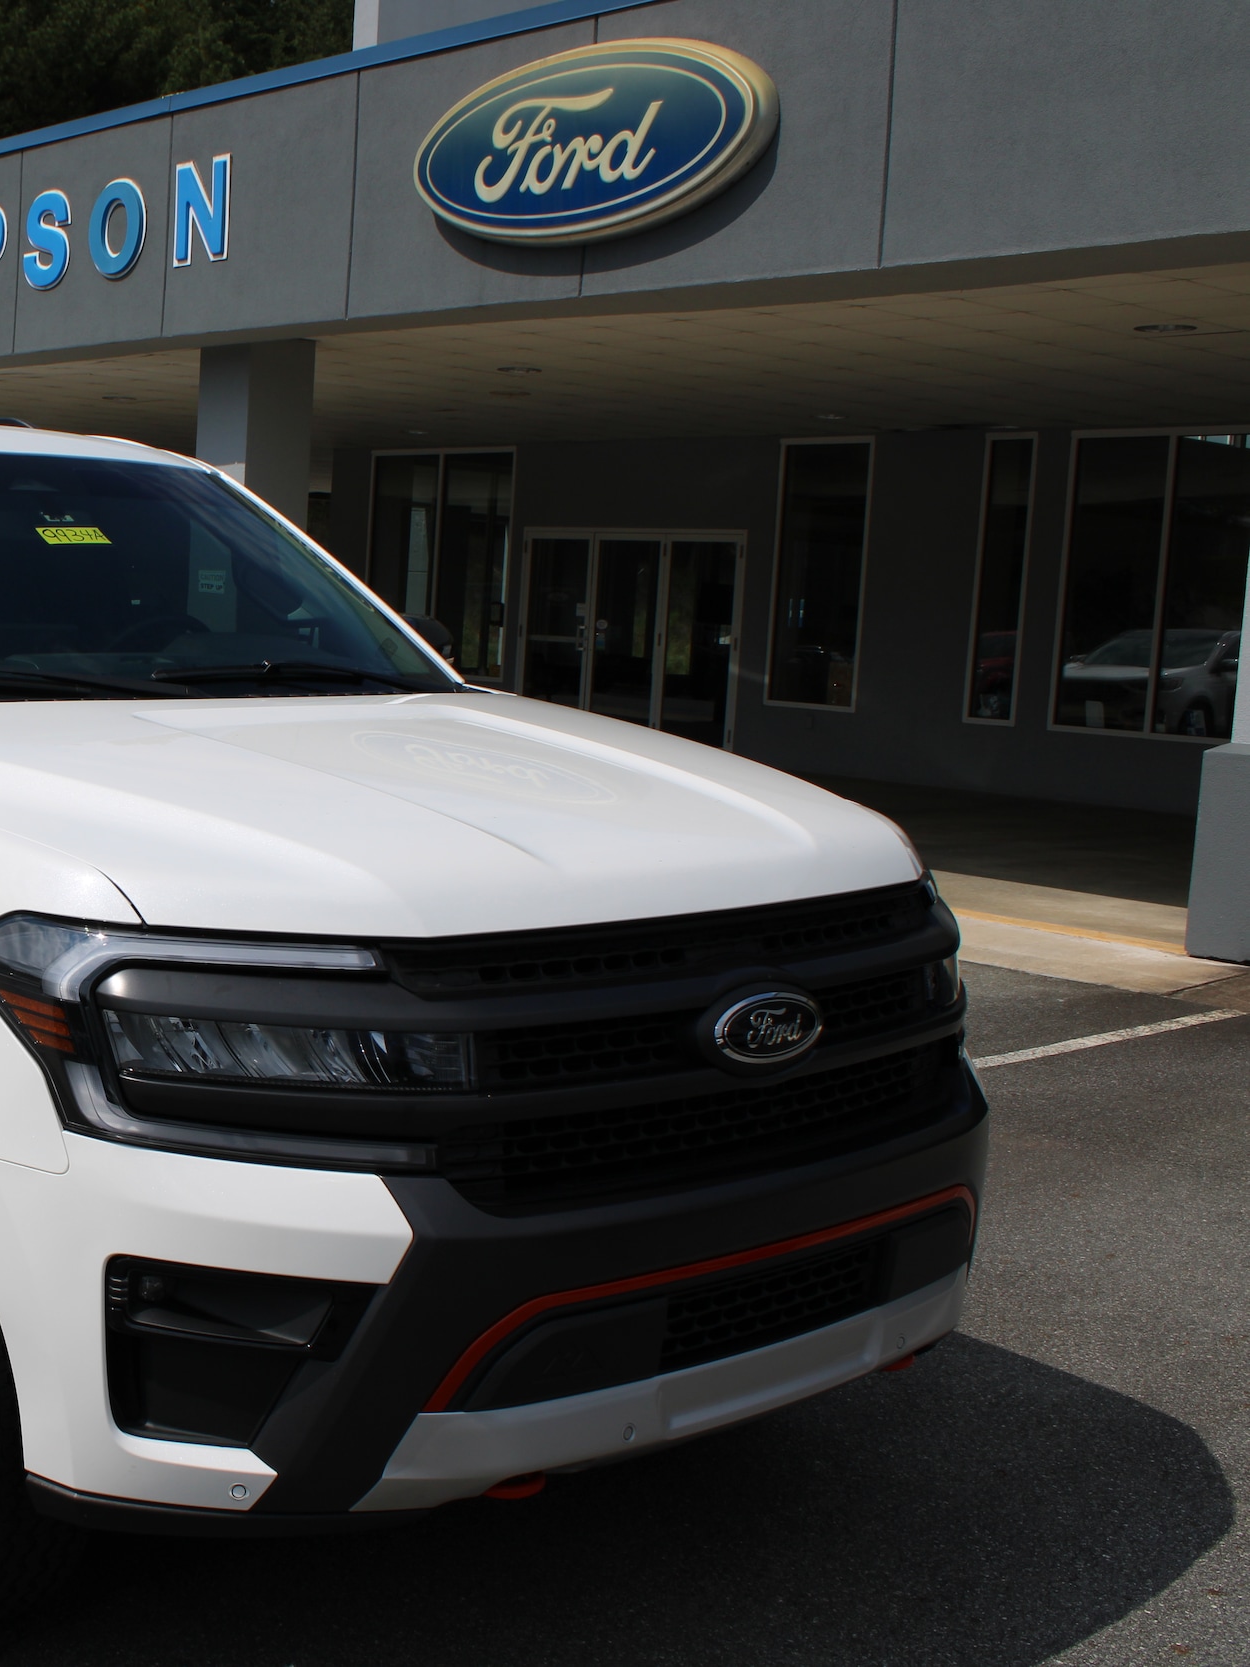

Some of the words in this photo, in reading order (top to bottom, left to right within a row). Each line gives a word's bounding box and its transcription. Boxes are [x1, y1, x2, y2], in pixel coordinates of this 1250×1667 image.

[474, 87, 664, 203] Ford
[41, 527, 106, 543] 9934A
[746, 1007, 803, 1049] Ford
